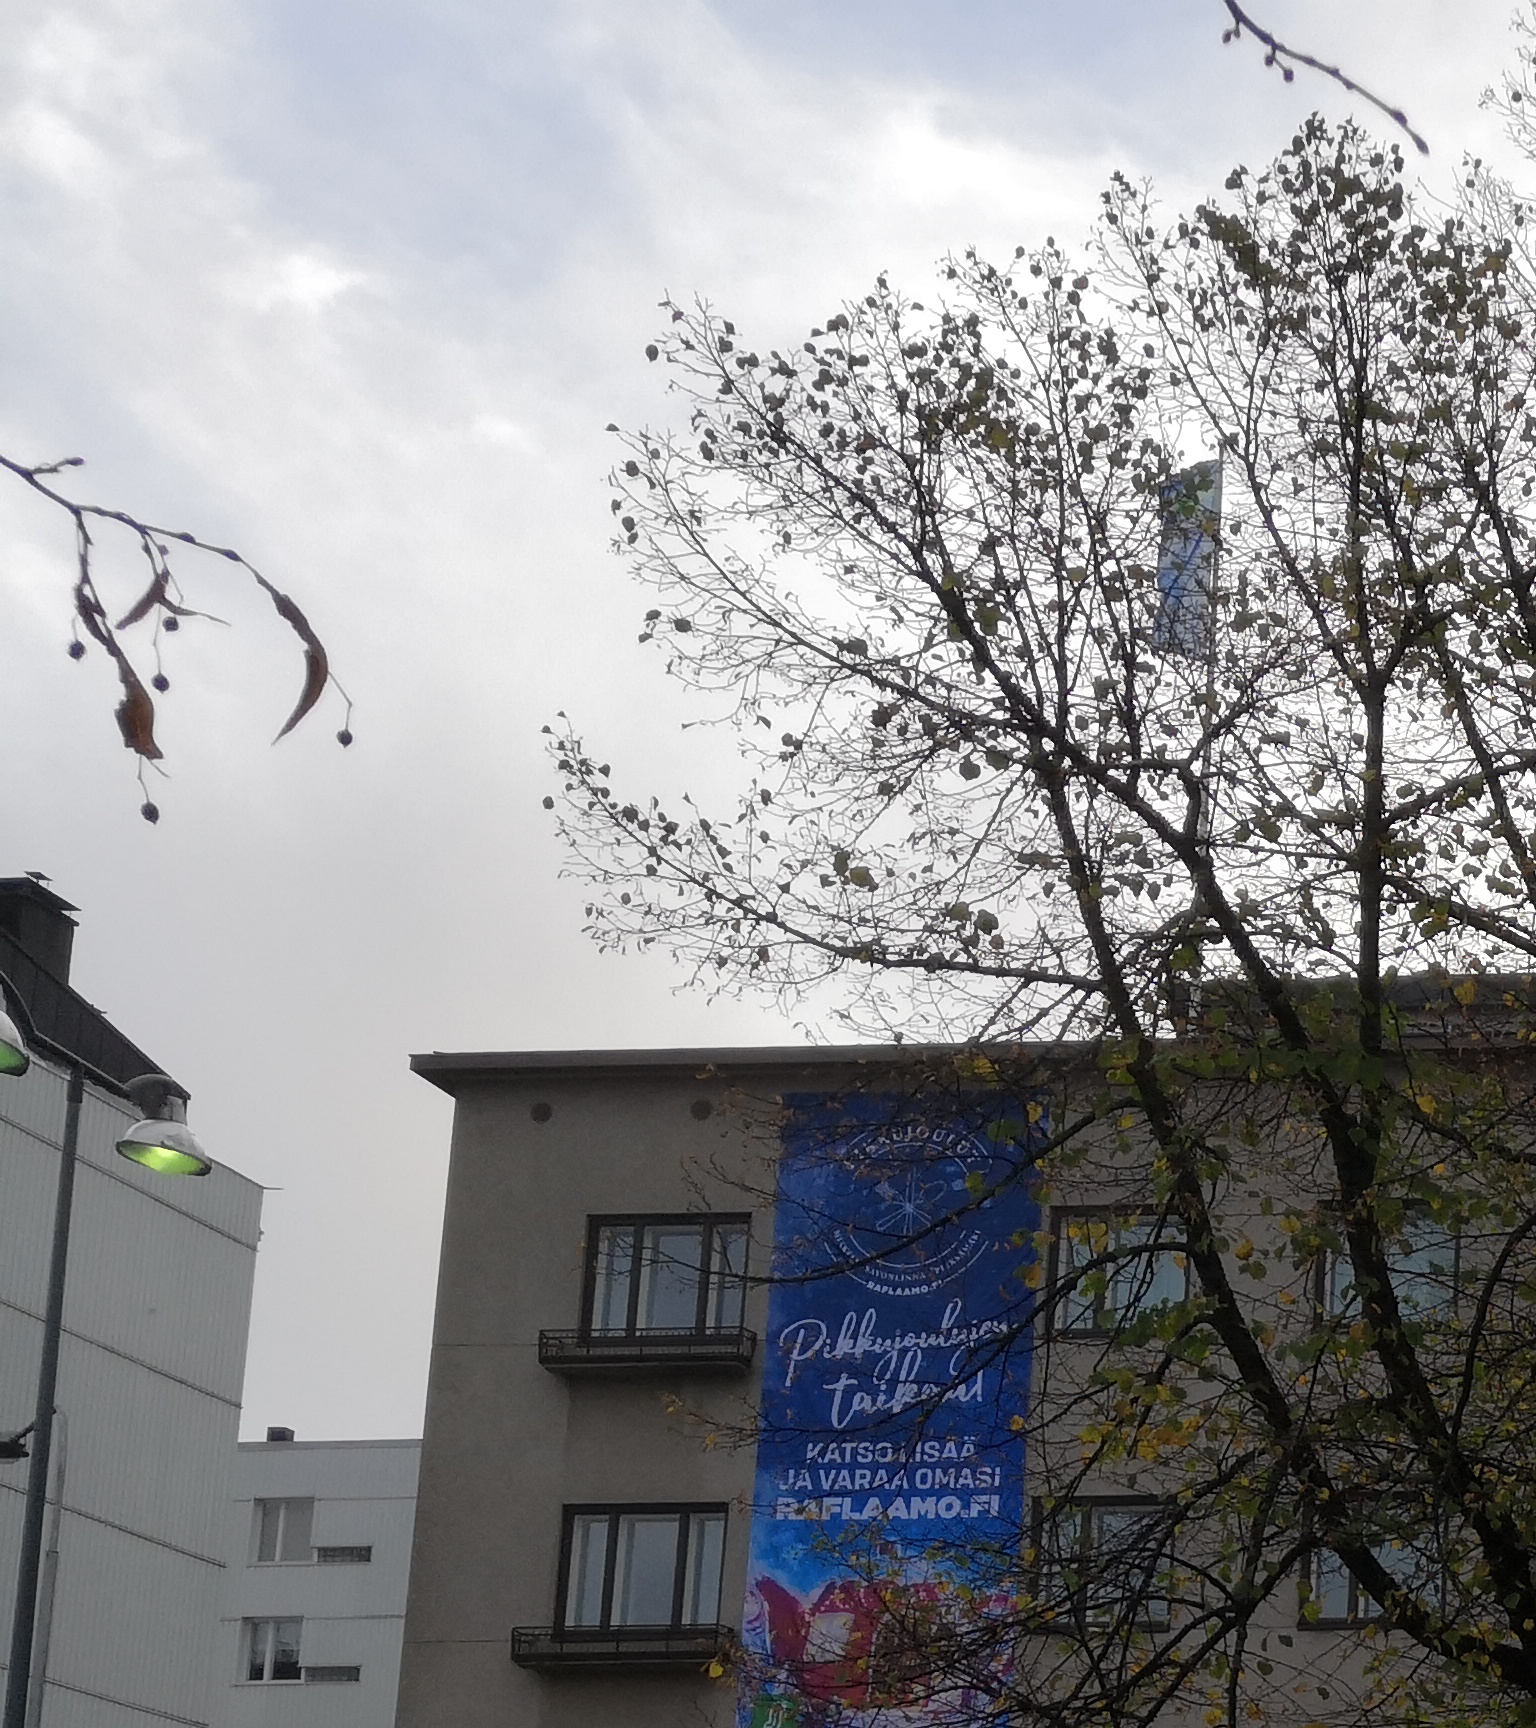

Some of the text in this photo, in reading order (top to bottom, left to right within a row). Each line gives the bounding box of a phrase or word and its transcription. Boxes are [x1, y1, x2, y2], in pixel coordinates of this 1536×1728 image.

[806, 1441, 894, 1464] KATSO
[779, 1466, 1001, 1491] JA VARAA OMASI
[776, 1494, 1000, 1521] RAFLAAMO.FI
